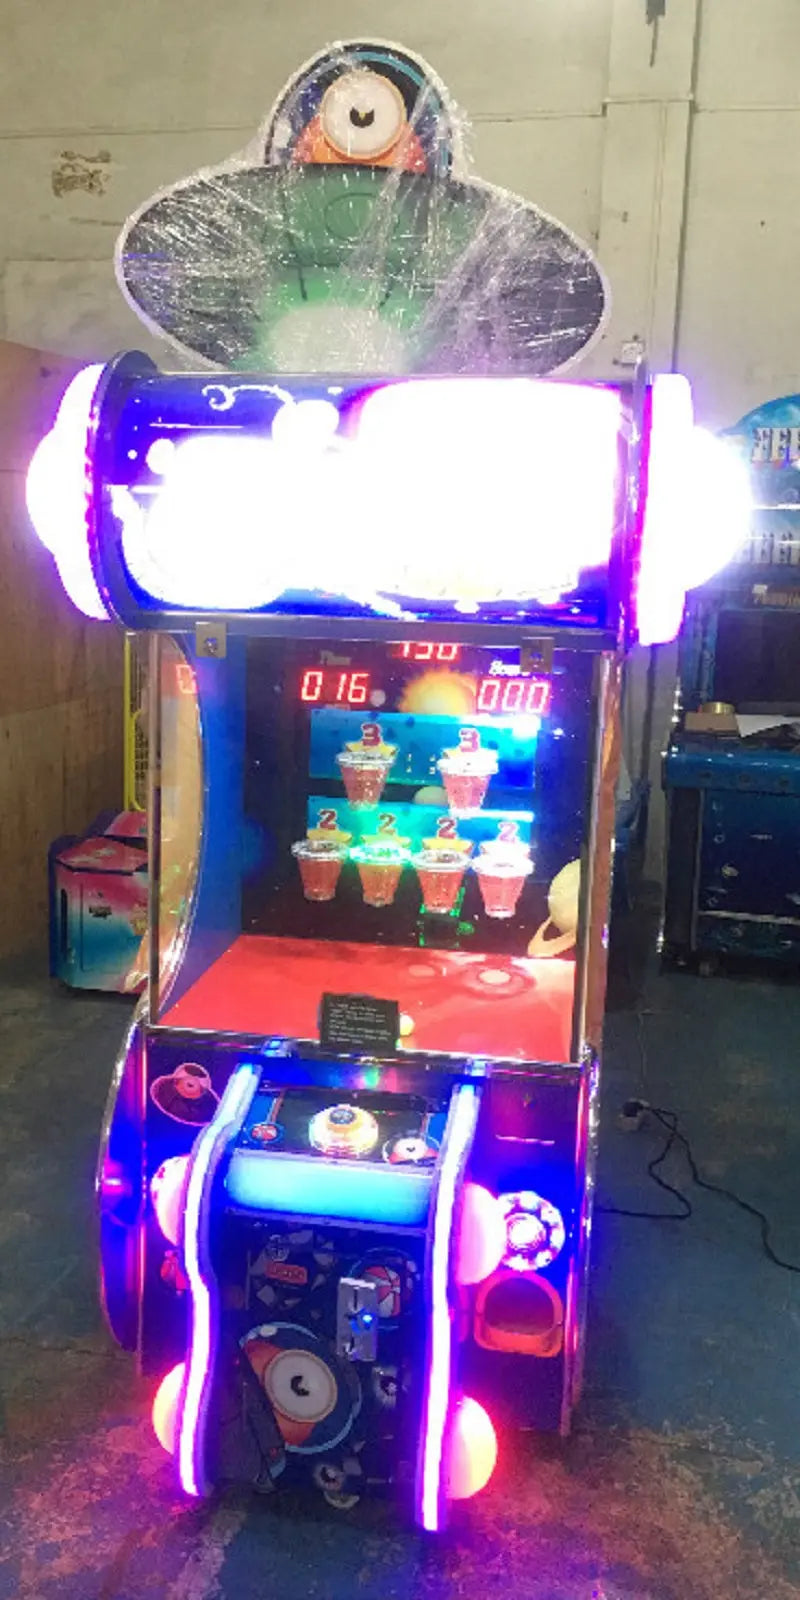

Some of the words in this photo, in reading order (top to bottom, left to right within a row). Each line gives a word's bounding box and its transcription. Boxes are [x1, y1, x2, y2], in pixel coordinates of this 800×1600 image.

[301, 671, 369, 703] 016
[478, 679, 549, 714] 000
[361, 722, 382, 747] 3
[459, 728, 480, 752] 3
[318, 808, 338, 831] 2
[378, 812, 398, 836] 2
[437, 816, 458, 840] 2
[498, 820, 519, 844] 2
